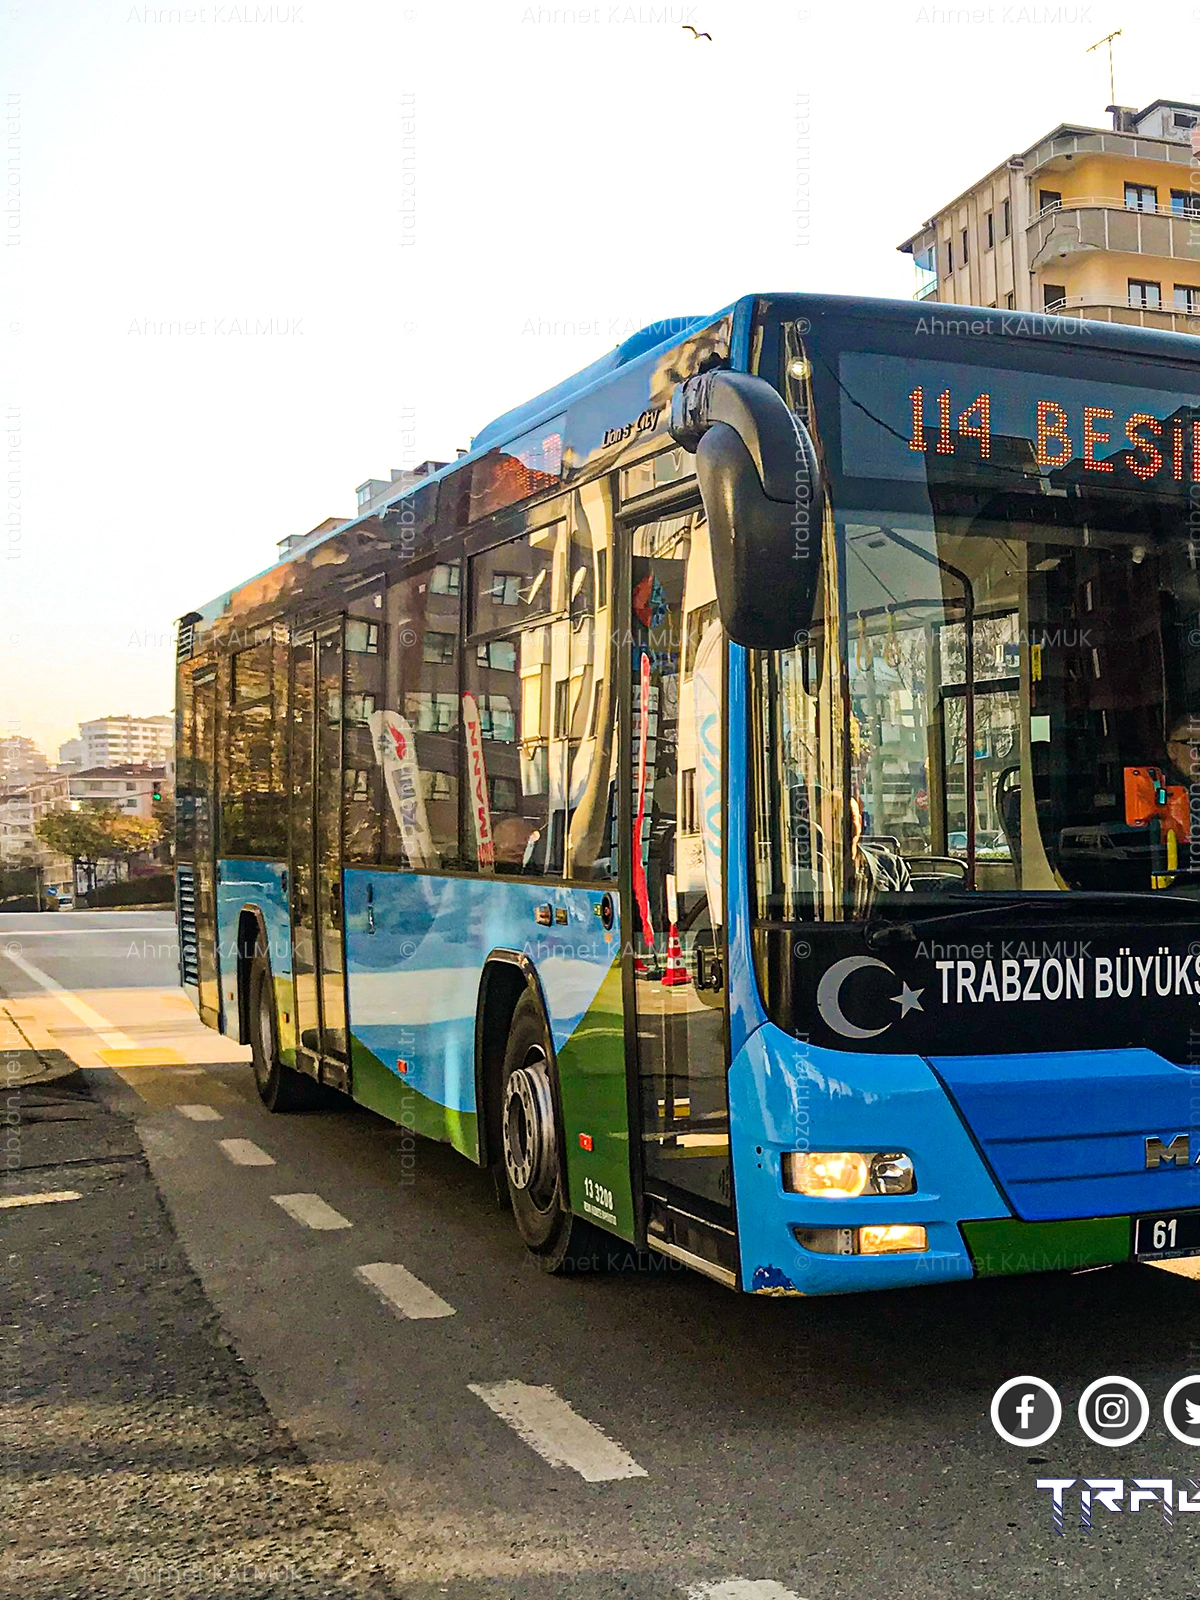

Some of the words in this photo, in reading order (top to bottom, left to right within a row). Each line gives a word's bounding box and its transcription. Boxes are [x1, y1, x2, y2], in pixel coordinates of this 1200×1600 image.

[636, 409, 661, 433] City
[908, 385, 991, 459] 114
[935, 957, 1085, 1004] TRABZON
[584, 1177, 594, 1199] 13
[594, 1182, 614, 1211] 3208
[1153, 1219, 1178, 1250] 61
